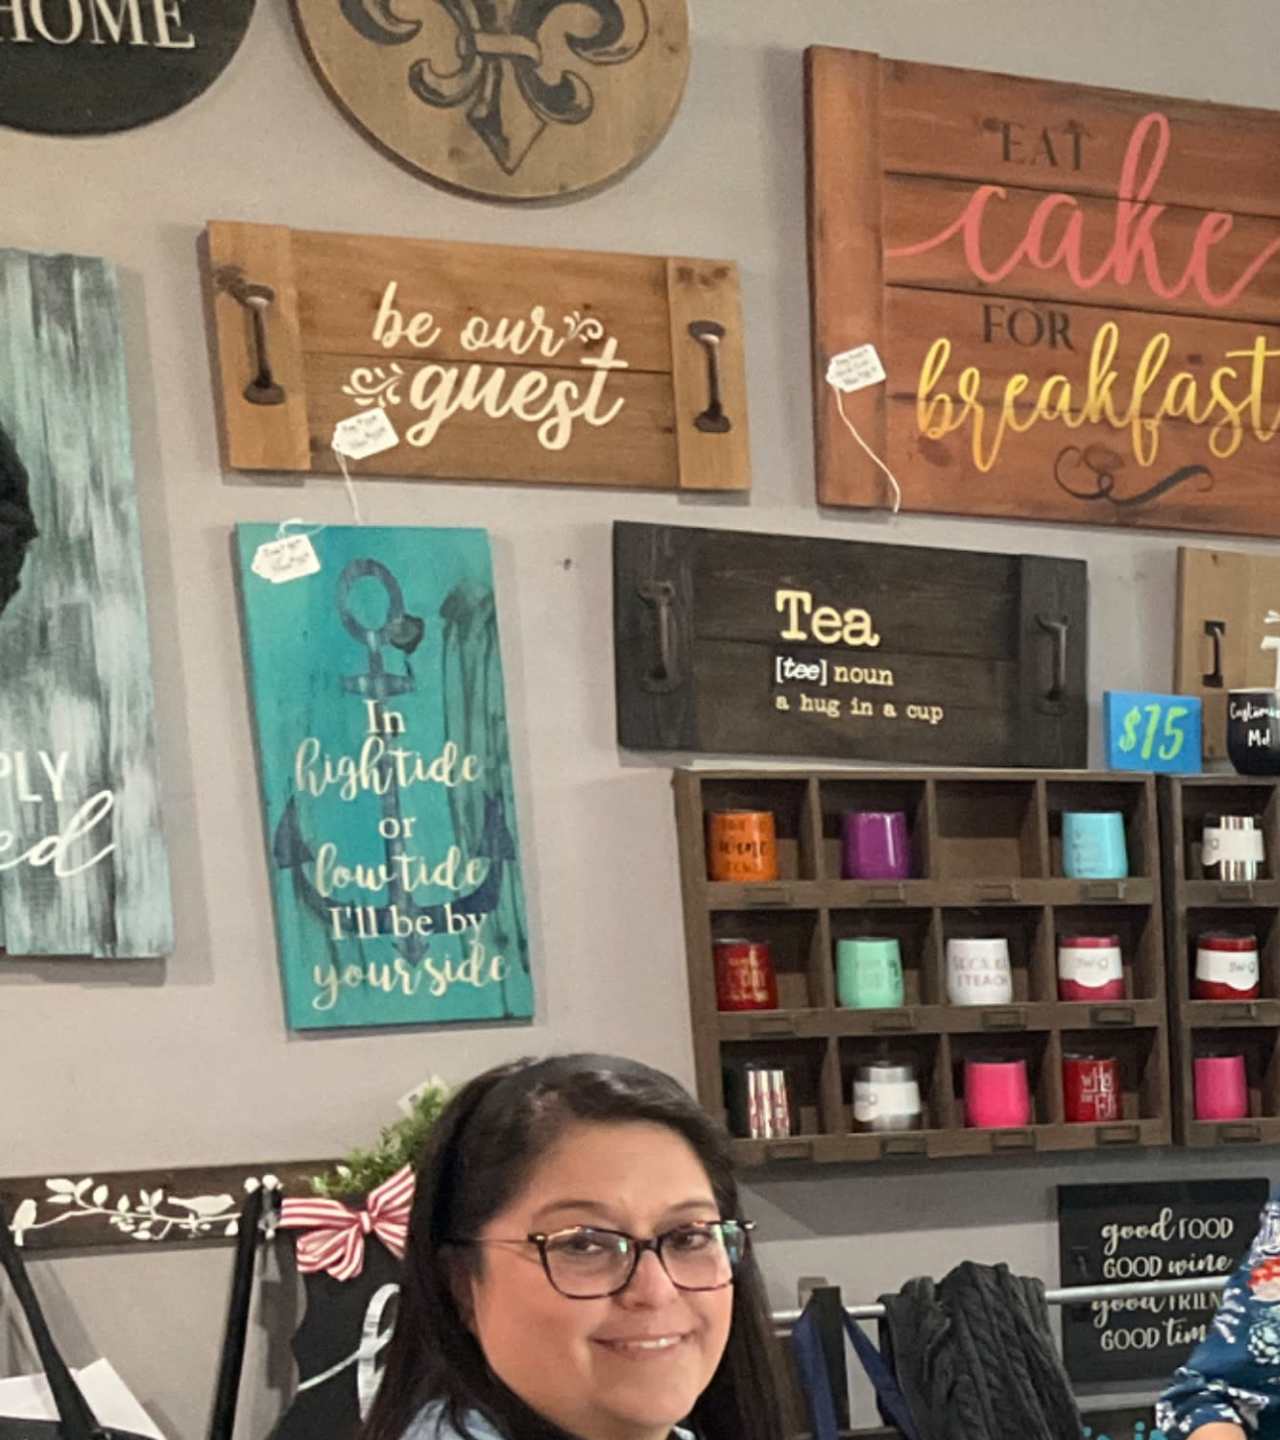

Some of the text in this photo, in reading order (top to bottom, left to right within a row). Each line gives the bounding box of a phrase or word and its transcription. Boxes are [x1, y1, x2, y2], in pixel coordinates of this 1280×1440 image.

[0, 0, 196, 49] HOME
[1000, 122, 1092, 172] EAT
[372, 281, 566, 357] be our
[982, 304, 1075, 351] FOR
[405, 336, 629, 450] guest
[775, 589, 881, 647] Tea
[775, 656, 895, 687] [tee] noun
[364, 699, 407, 733] In
[775, 693, 945, 725] a hug in a cup
[1117, 702, 1190, 761] $15
[295, 736, 483, 802] high tide
[378, 816, 417, 840] or
[315, 842, 492, 898] low tide
[328, 902, 488, 945] I'll be by
[311, 941, 511, 1012] your side
[1101, 1207, 1235, 1256] good FOOD
[1103, 1253, 1234, 1279] GOOD wine
[1091, 1295, 1166, 1329] good
[1101, 1327, 1161, 1351] GOOD
